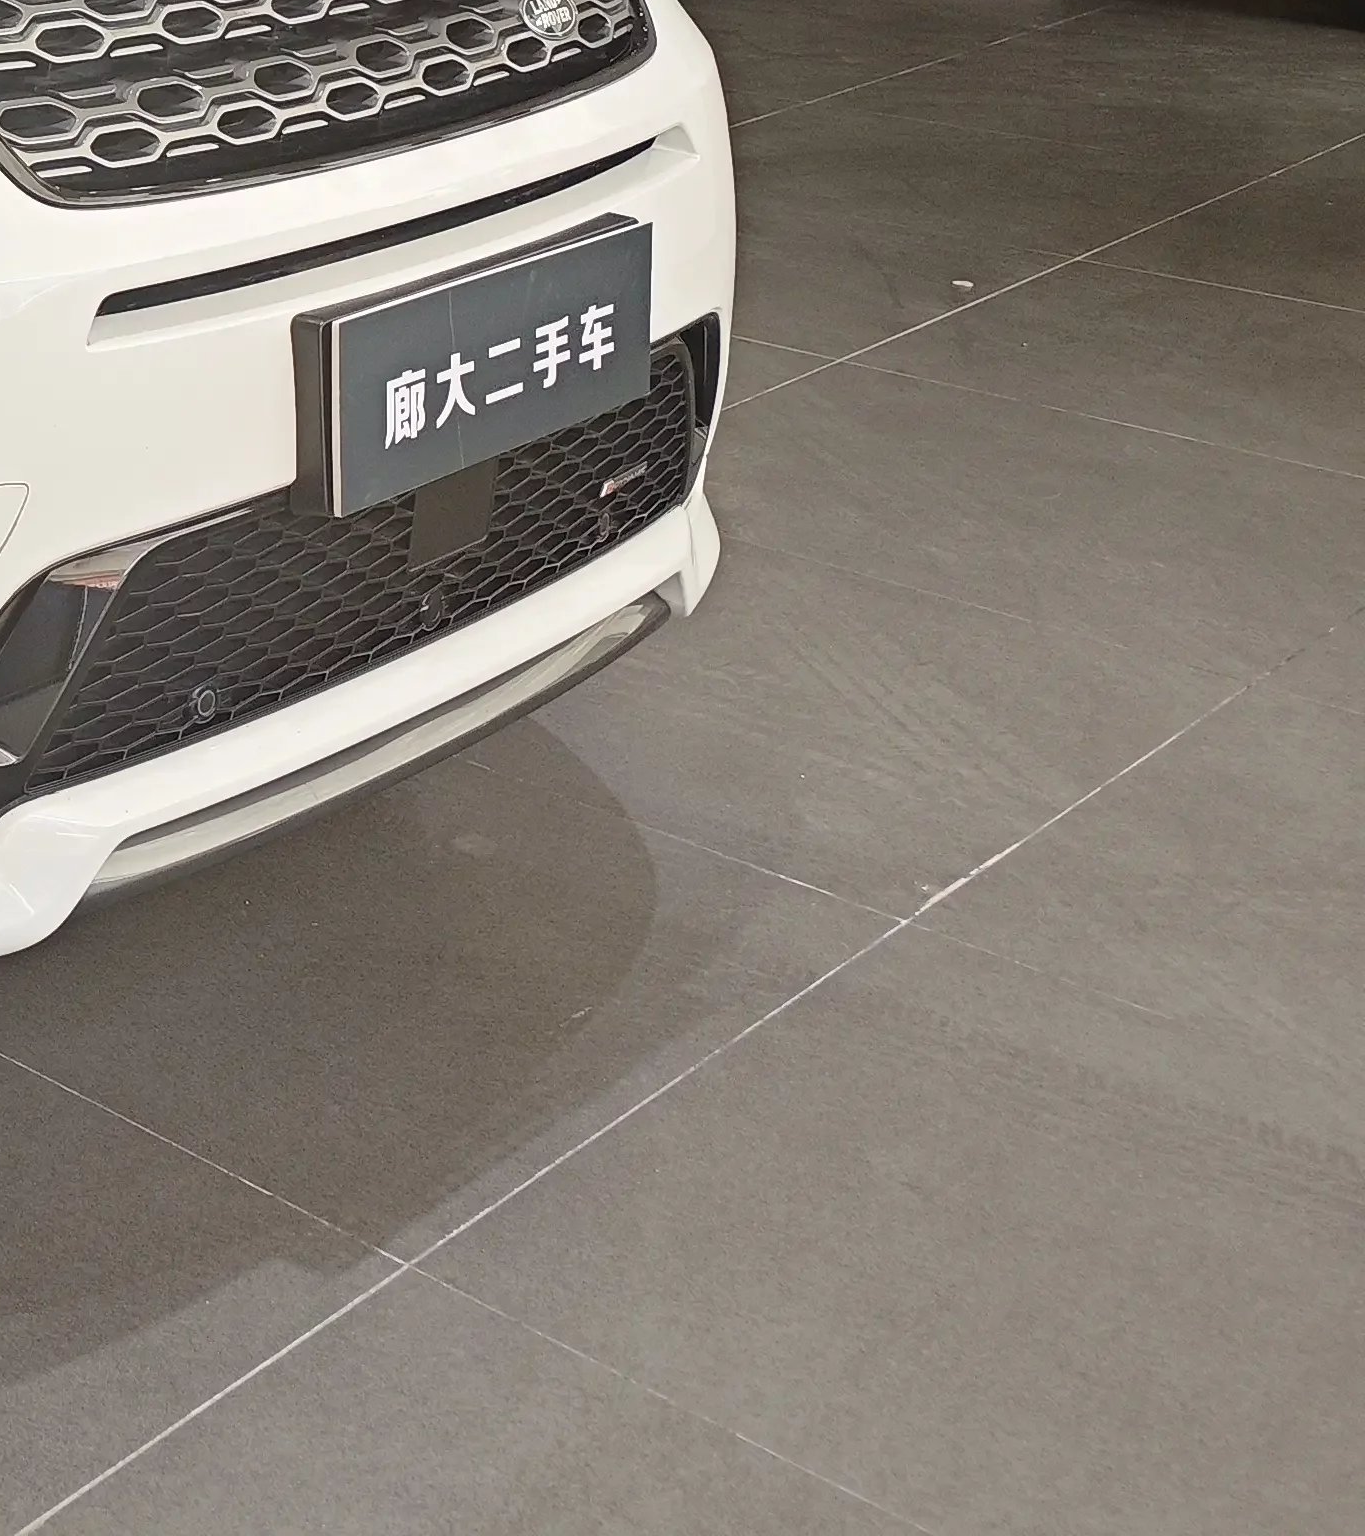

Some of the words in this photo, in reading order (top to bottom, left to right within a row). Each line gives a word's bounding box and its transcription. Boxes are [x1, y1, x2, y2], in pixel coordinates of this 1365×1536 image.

[540, 7, 572, 29] ROVER
[384, 303, 615, 450] 廊大二手车
